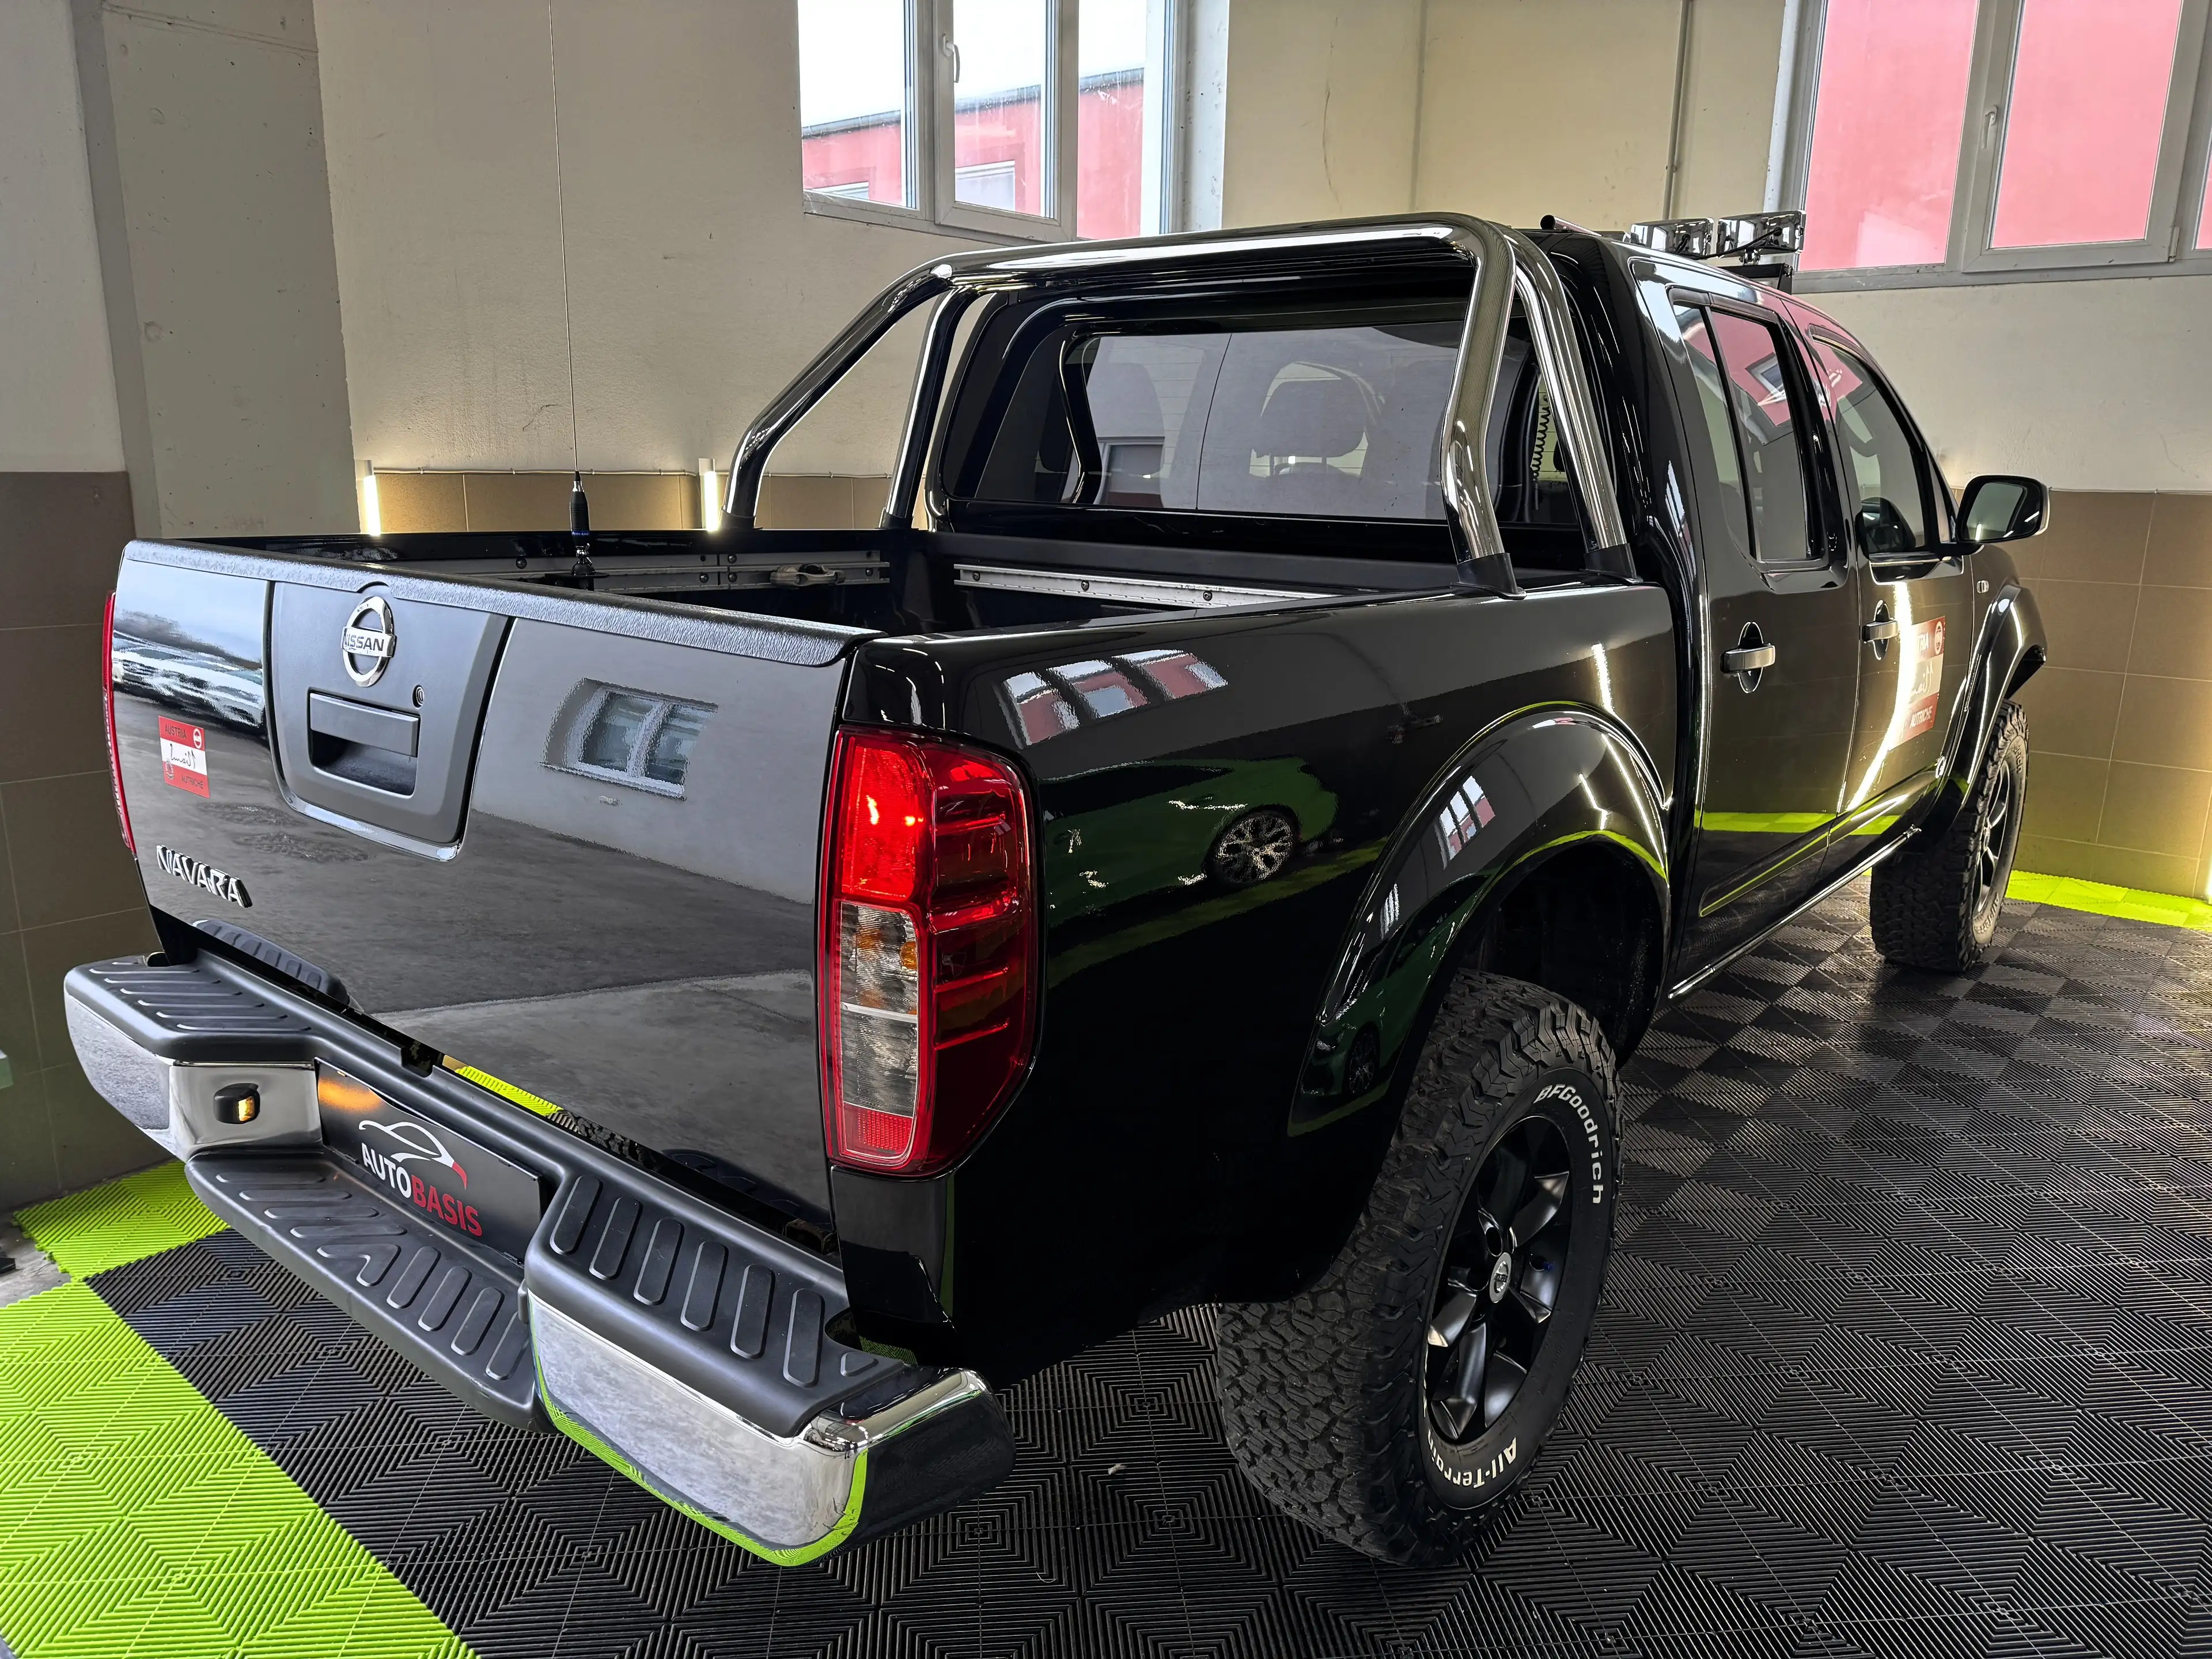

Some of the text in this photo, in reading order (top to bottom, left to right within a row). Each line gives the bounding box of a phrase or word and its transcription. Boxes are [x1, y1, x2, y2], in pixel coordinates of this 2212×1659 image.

[343, 632, 384, 652] NISSAN
[165, 725, 187, 739] AUSTRIA
[181, 773, 203, 789] AUTRICHE
[156, 844, 252, 908] NAVARA
[1533, 1084, 1604, 1204] BFGoodrich
[362, 1143, 483, 1236] AUTOBASIS
[1427, 1428, 1517, 1488] All-Terrain
